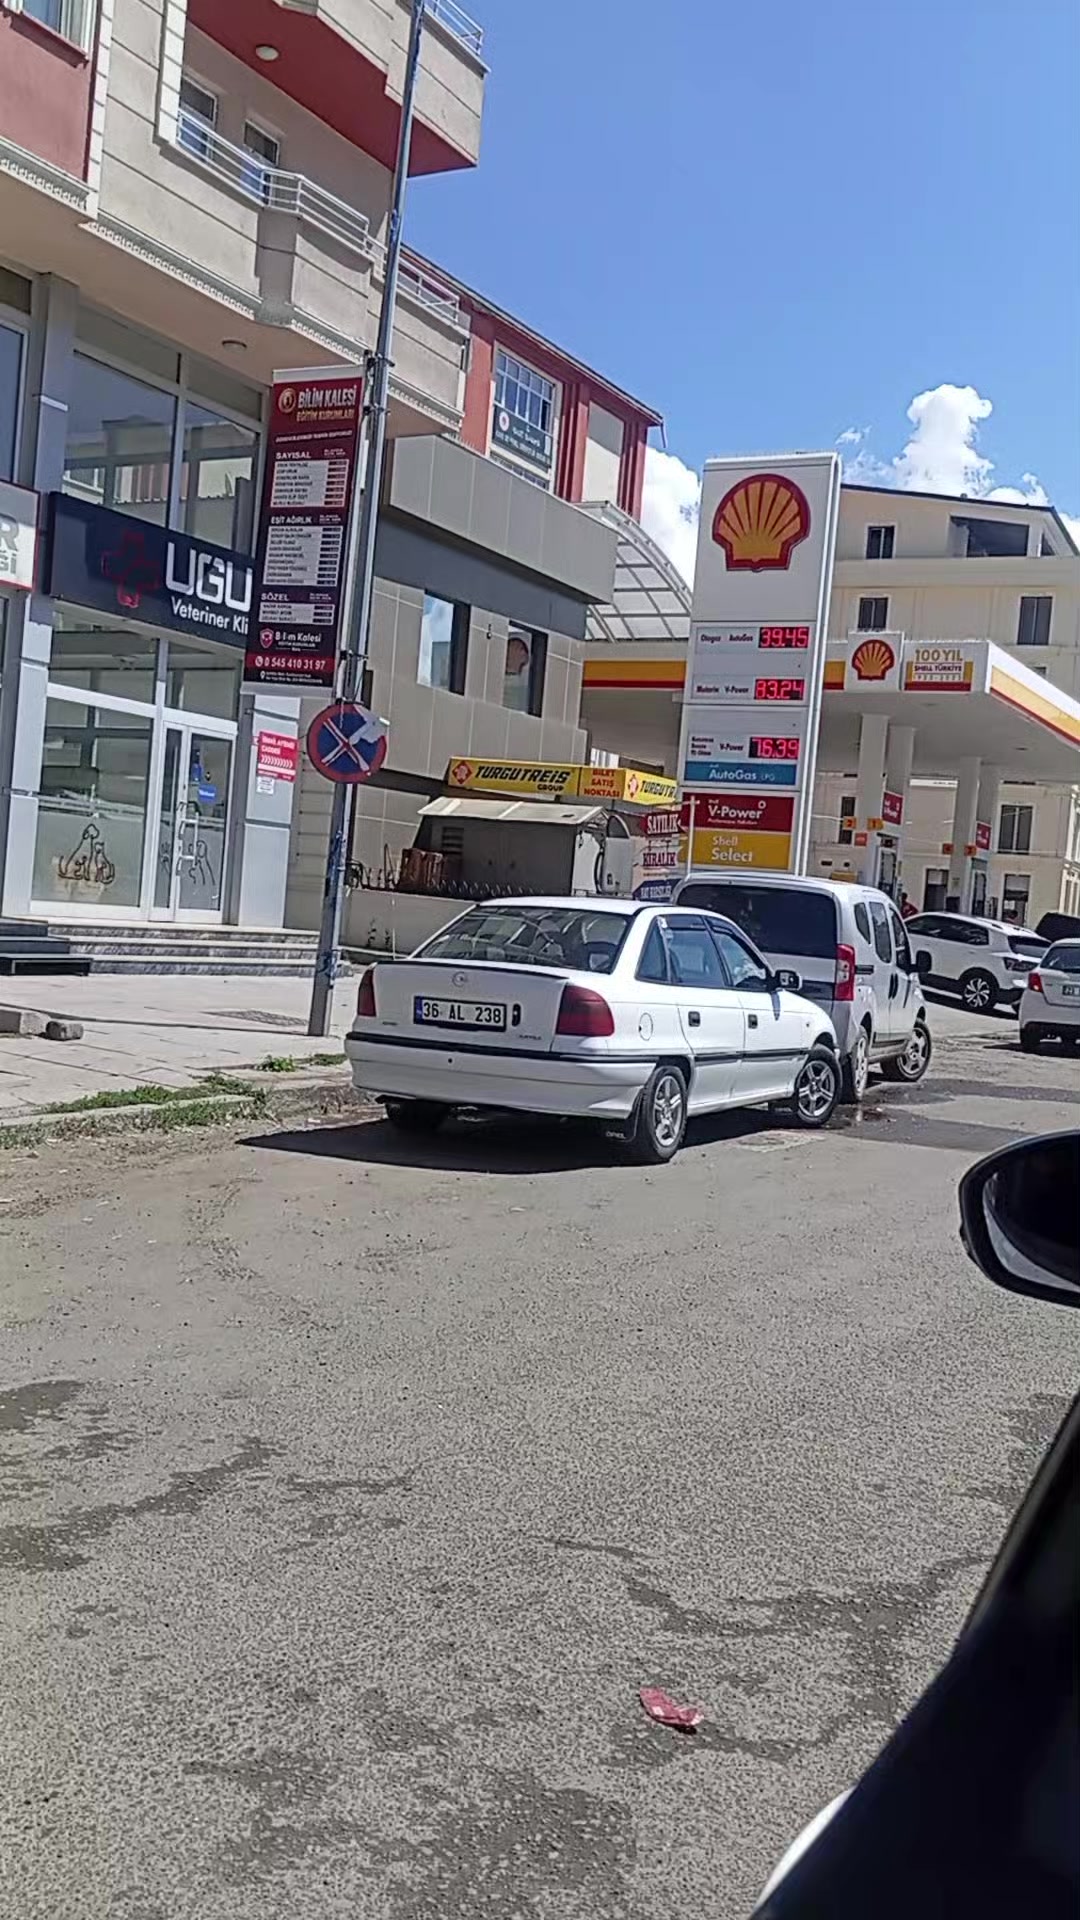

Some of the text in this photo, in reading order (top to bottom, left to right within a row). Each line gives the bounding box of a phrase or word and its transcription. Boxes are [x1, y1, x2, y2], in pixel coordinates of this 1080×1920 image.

[297, 385, 357, 408] BİLİM KALESİ
[276, 451, 311, 459] SAYISAL
[171, 596, 230, 629] Veteriner
[760, 628, 808, 647] 39.45
[915, 649, 940, 661] 100
[271, 657, 286, 668] 545
[287, 658, 302, 669] 410
[303, 659, 313, 669] 31
[315, 660, 326, 670] 97
[755, 680, 804, 699] 83.24
[752, 738, 800, 759] 76.39
[709, 769, 757, 780] AutoGas
[537, 783, 565, 792] GROUP
[584, 788, 620, 797] NOKTASI
[708, 805, 763, 819] V-Power
[647, 814, 678, 834] SATILIK
[712, 836, 738, 846] Shell
[711, 847, 753, 862] Select
[423, 1002, 501, 1024] 36 AL 238
